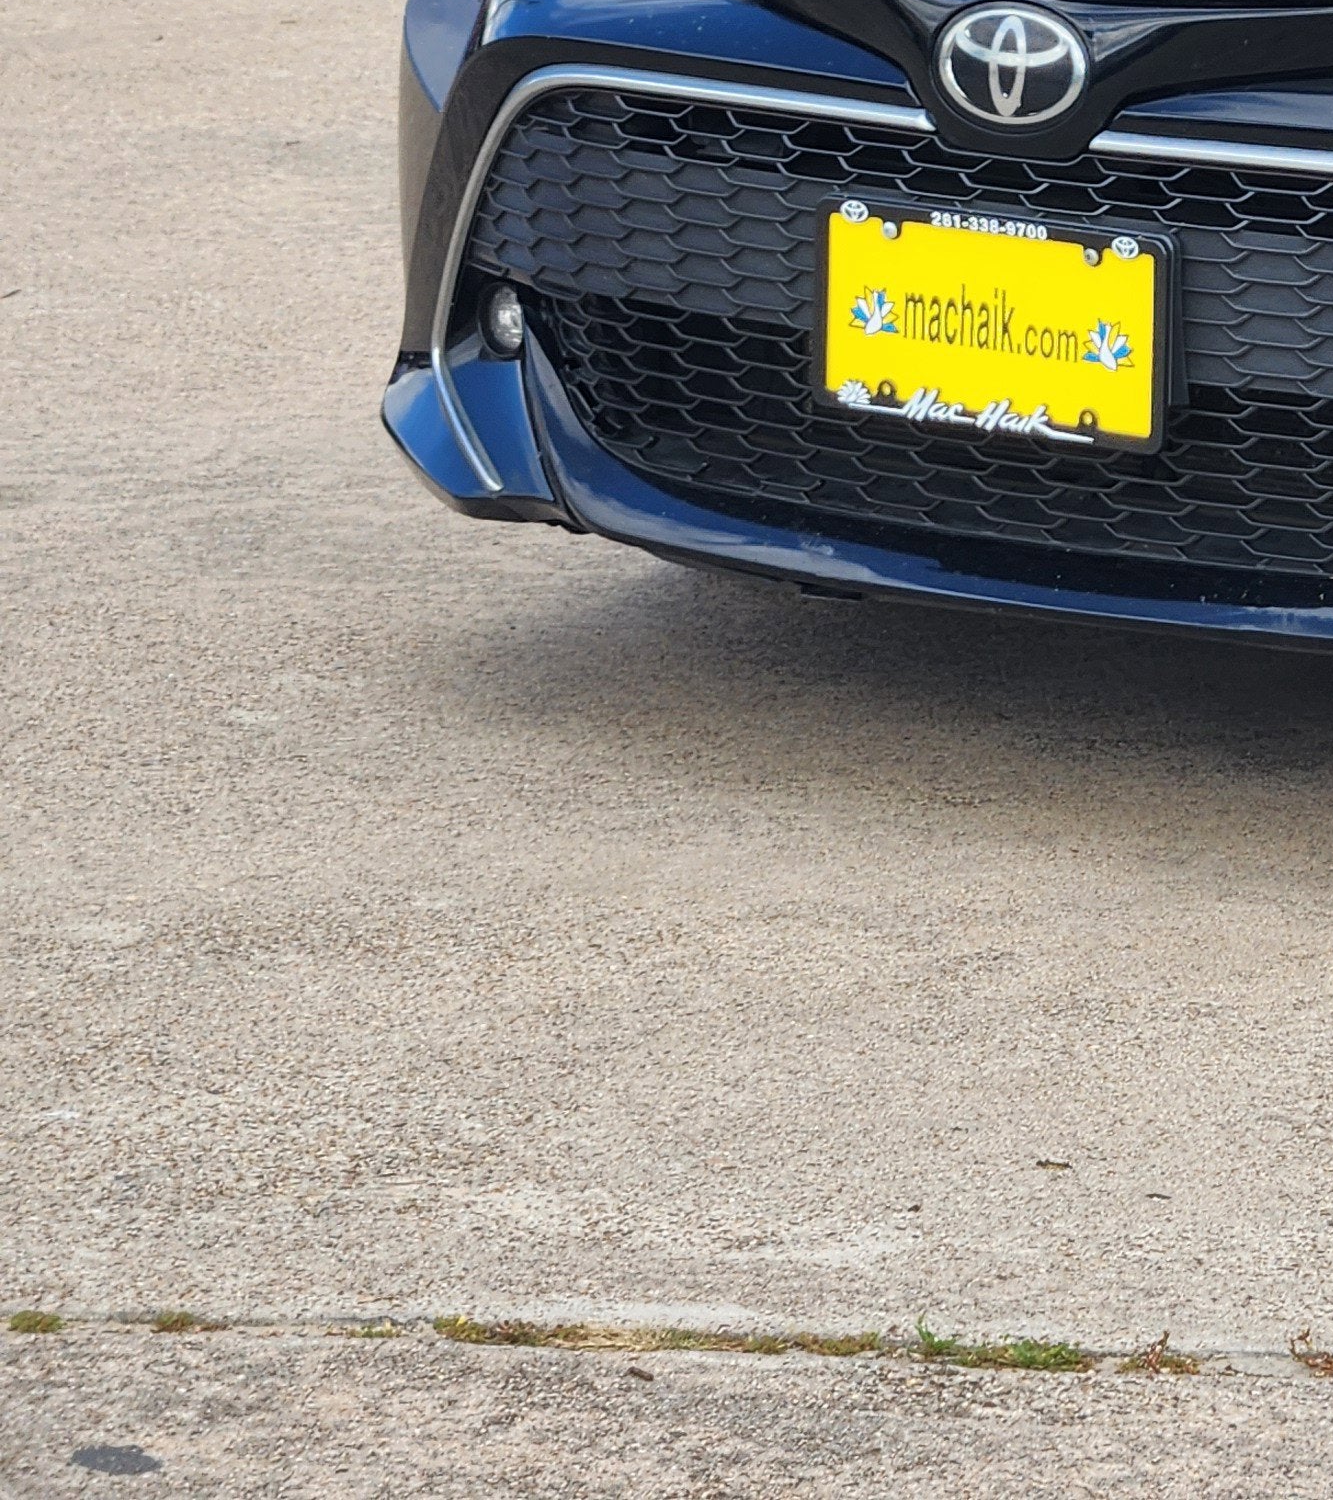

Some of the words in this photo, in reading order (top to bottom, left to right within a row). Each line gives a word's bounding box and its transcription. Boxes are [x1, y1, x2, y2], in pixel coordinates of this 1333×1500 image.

[930, 211, 1048, 240] 281-338-9700
[902, 284, 1078, 362] machaik.com
[897, 388, 975, 422] Mac
[974, 398, 1066, 436] Haik
